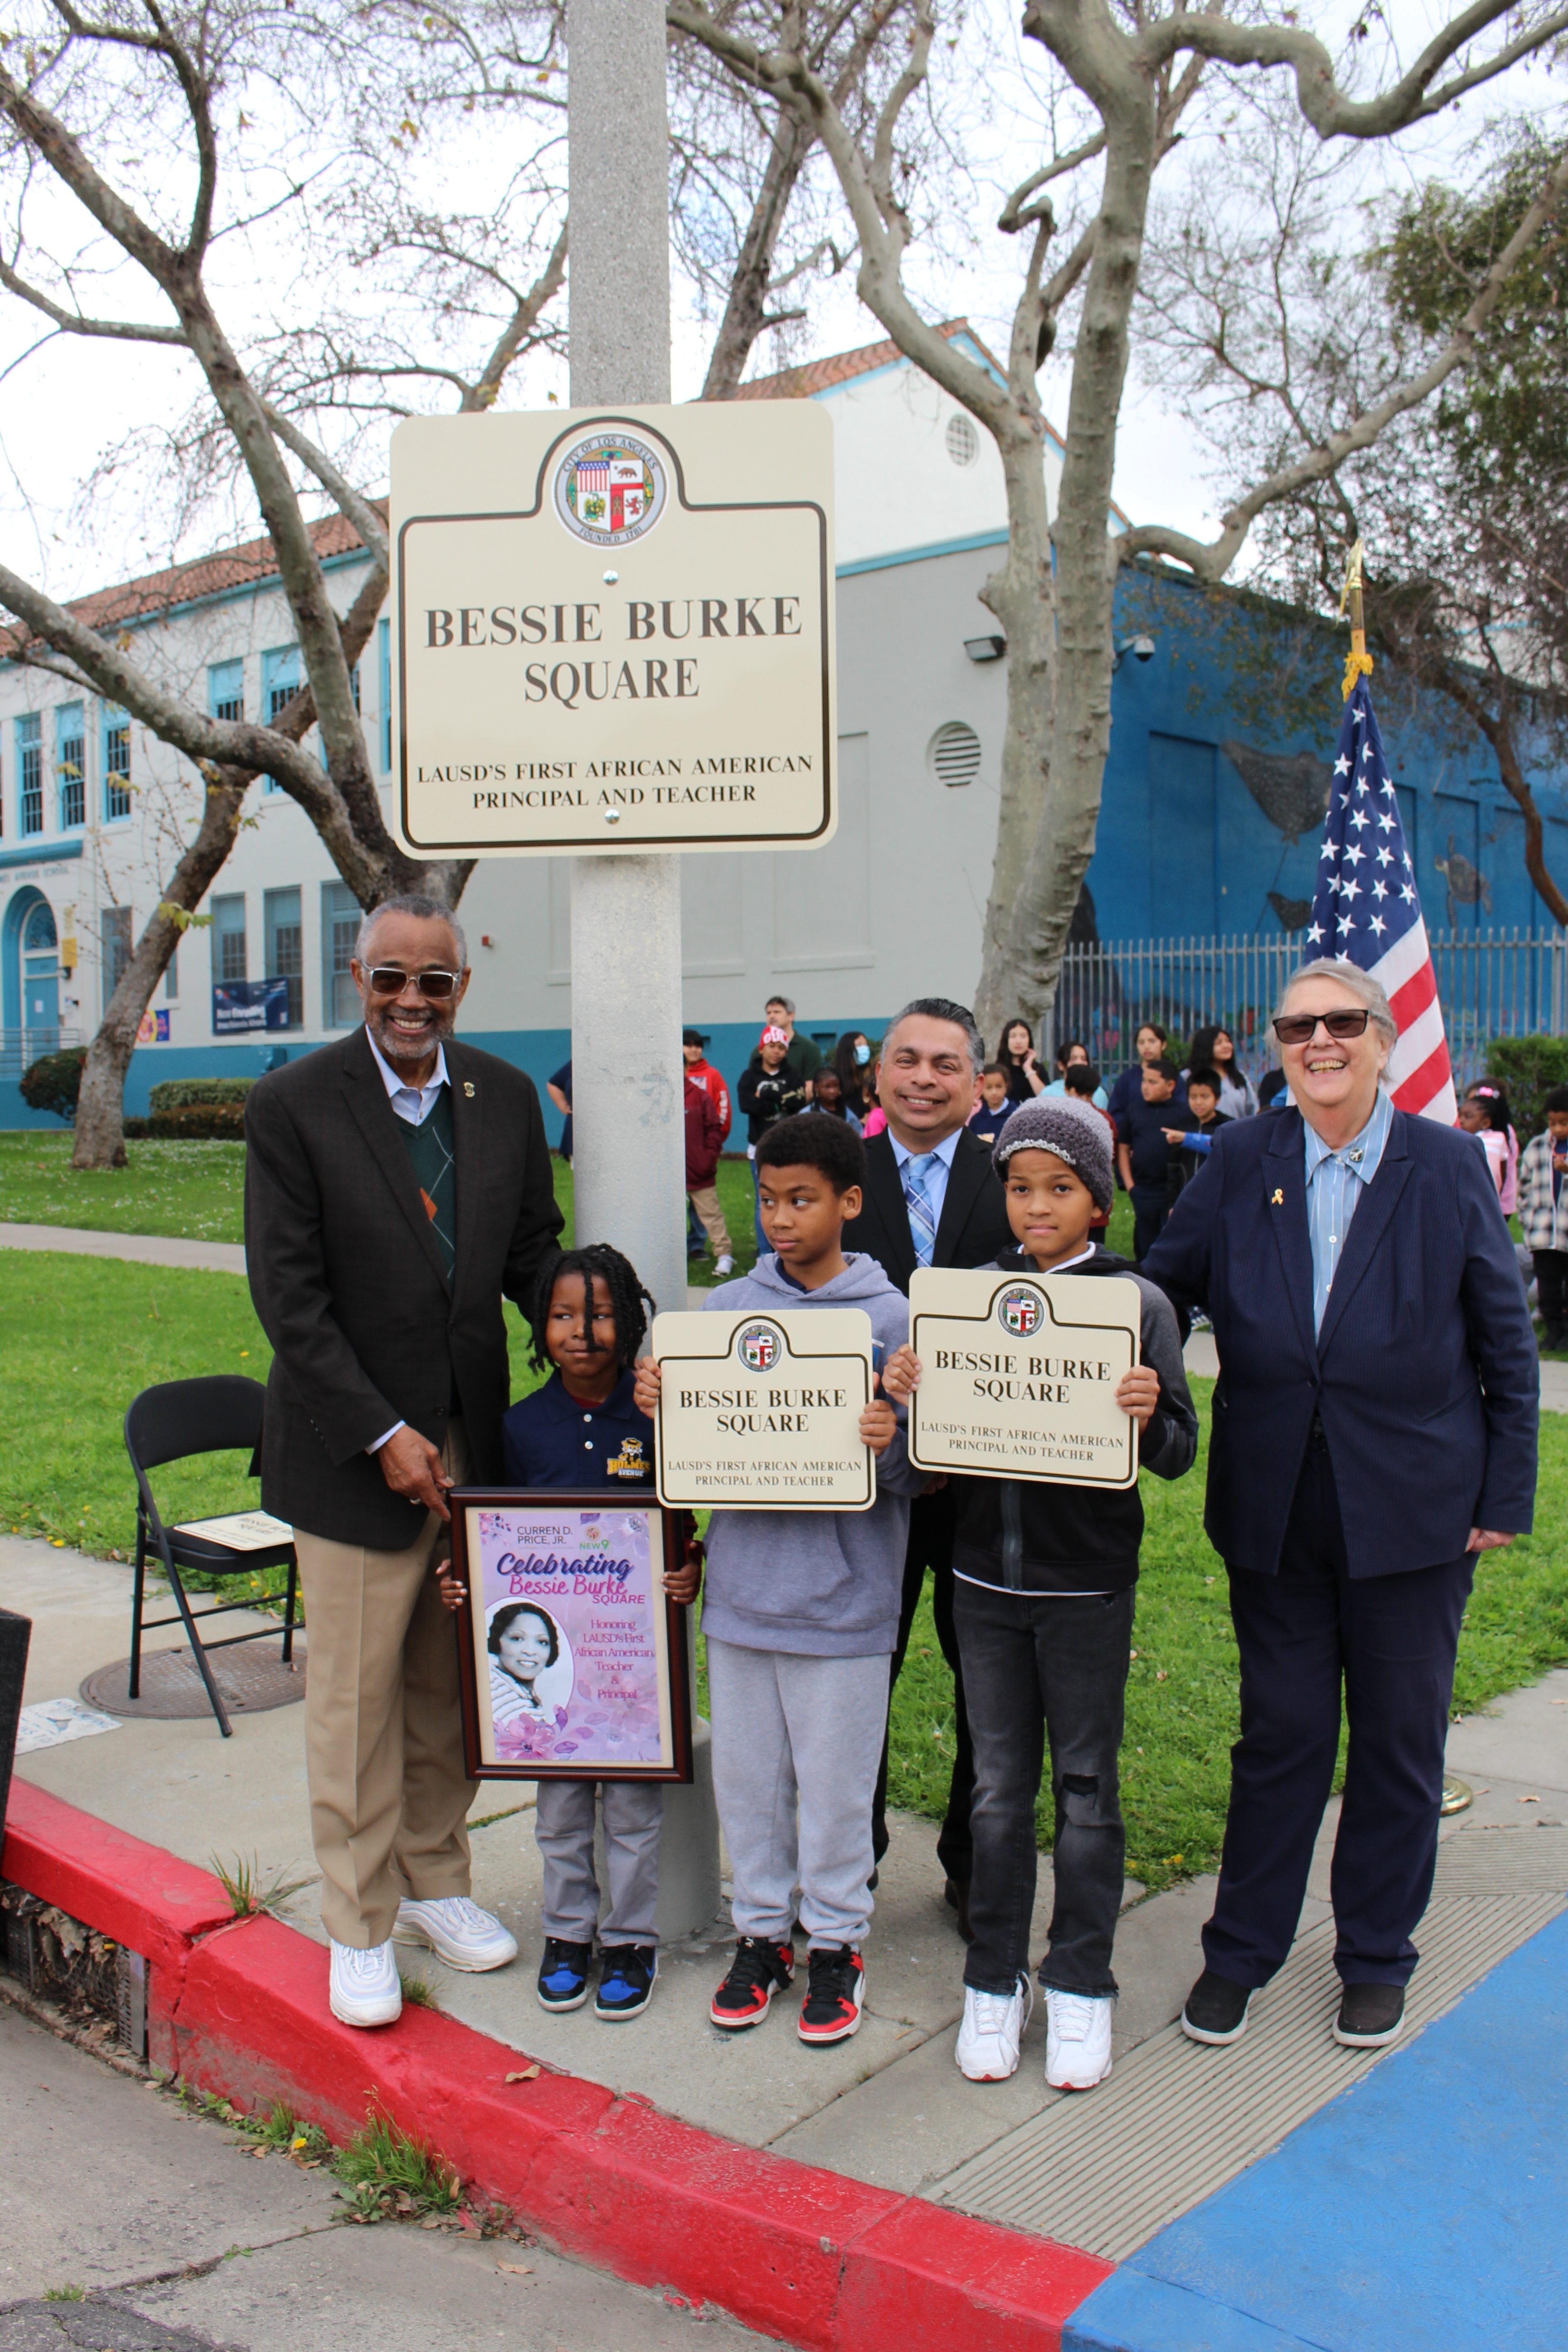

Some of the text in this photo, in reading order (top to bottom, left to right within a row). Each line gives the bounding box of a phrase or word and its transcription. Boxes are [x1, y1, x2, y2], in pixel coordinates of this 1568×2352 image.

[564, 437, 657, 472] CITY OF LOS ANGELES
[579, 525, 644, 543] FOUNDED 1781
[424, 596, 803, 648] BESSIE BURKE
[524, 658, 700, 710] SQUARE
[417, 755, 813, 783] LAUSD'S FIRST AFRICAN AMERICAN
[472, 785, 757, 809] PRINCIPAL AND TEACHER
[935, 1350, 1111, 1381] BESSIE BURKE
[679, 1389, 847, 1408] BESSIE BURKE
[973, 1378, 1070, 1403] SQUARE
[717, 1414, 809, 1436] SQUARE
[921, 1421, 1124, 1448] LAUSD'S FIRST AFRICAN AMERICAN
[949, 1439, 1094, 1461] PRINCIPAL AND TEACHER
[668, 1460, 862, 1471] LAUSD'S FIRST AFRICAN AMERICAN
[695, 1475, 834, 1486] PRINCIPAL AND TEACHER
[517, 1526, 573, 1535] CURREN D.
[518, 1535, 566, 1545] PRICE, JR.
[601, 1539, 609, 1549] 9
[497, 1553, 635, 1581] Celebrating
[510, 1573, 628, 1595] Bessie Burke
[593, 1595, 645, 1606] SQUARE
[591, 1619, 637, 1632] Honoring
[583, 1633, 645, 1643] LAUSD's First
[575, 1647, 653, 1656] African American
[595, 1661, 634, 1671] Teacher
[611, 1675, 620, 1684] &
[598, 1689, 637, 1701] Principal
